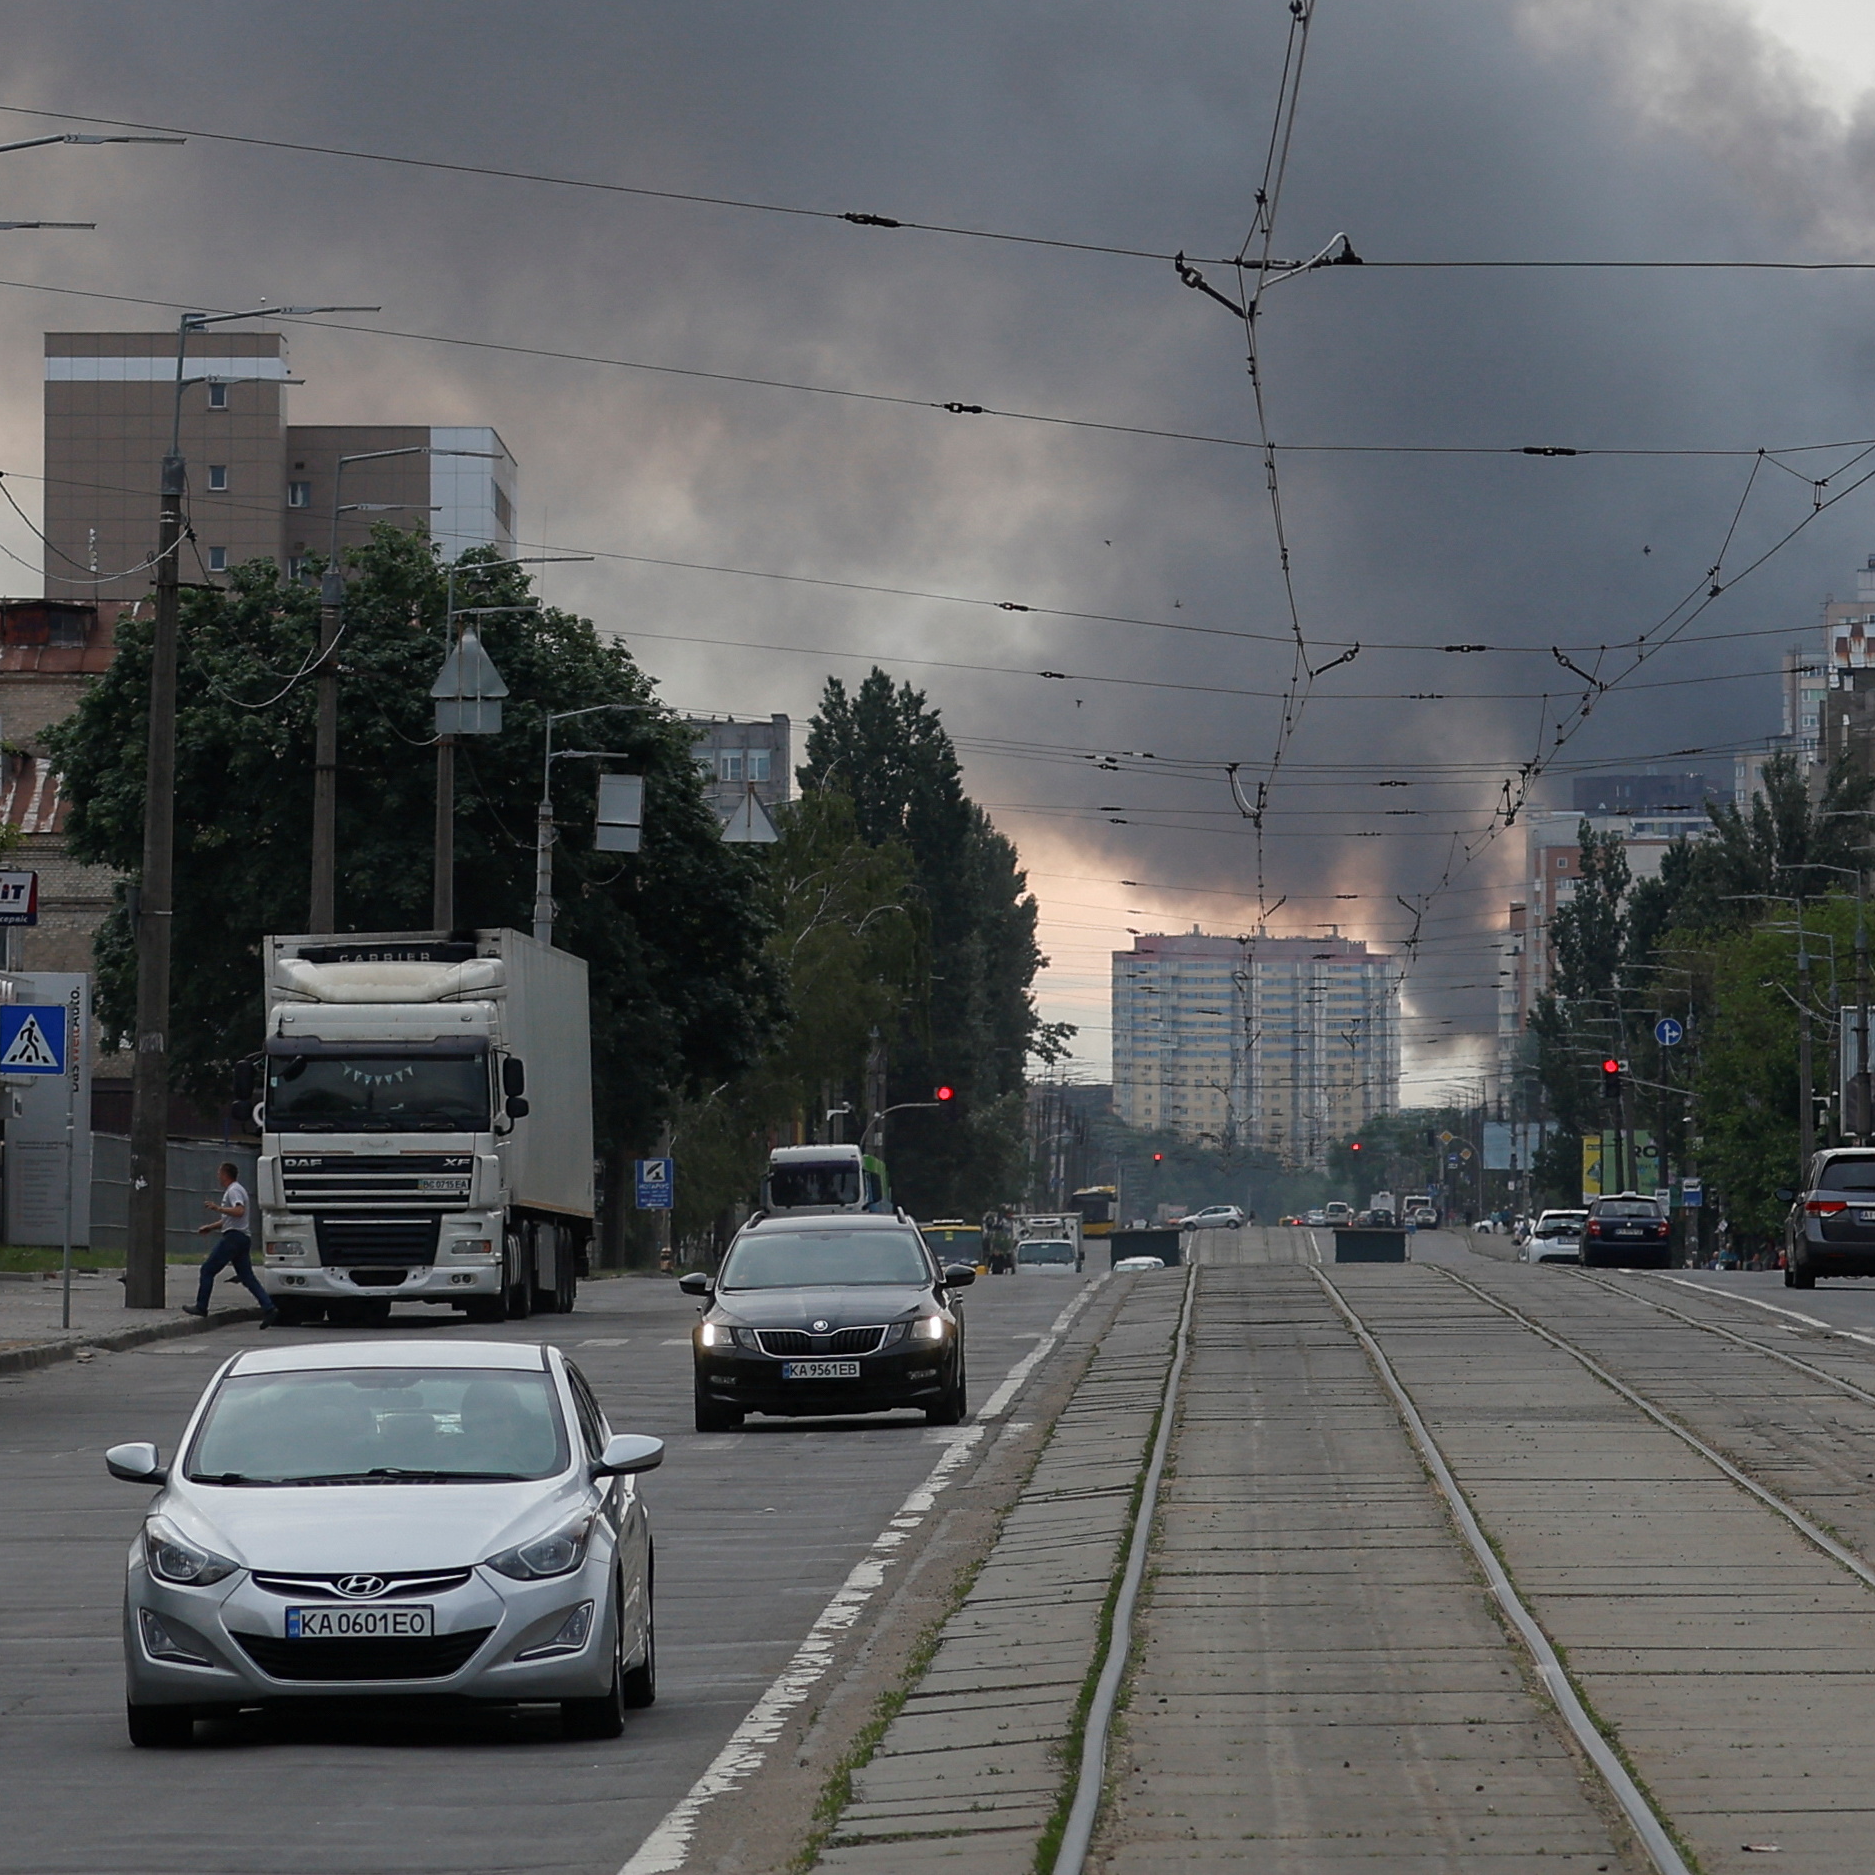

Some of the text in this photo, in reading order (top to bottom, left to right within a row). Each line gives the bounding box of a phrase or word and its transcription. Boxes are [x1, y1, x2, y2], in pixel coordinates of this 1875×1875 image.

[284, 1158, 323, 1167] DAF
[442, 1158, 471, 1166] XF
[789, 1364, 808, 1376] KA
[301, 1613, 333, 1635] KA
[338, 1613, 388, 1634] 0601
